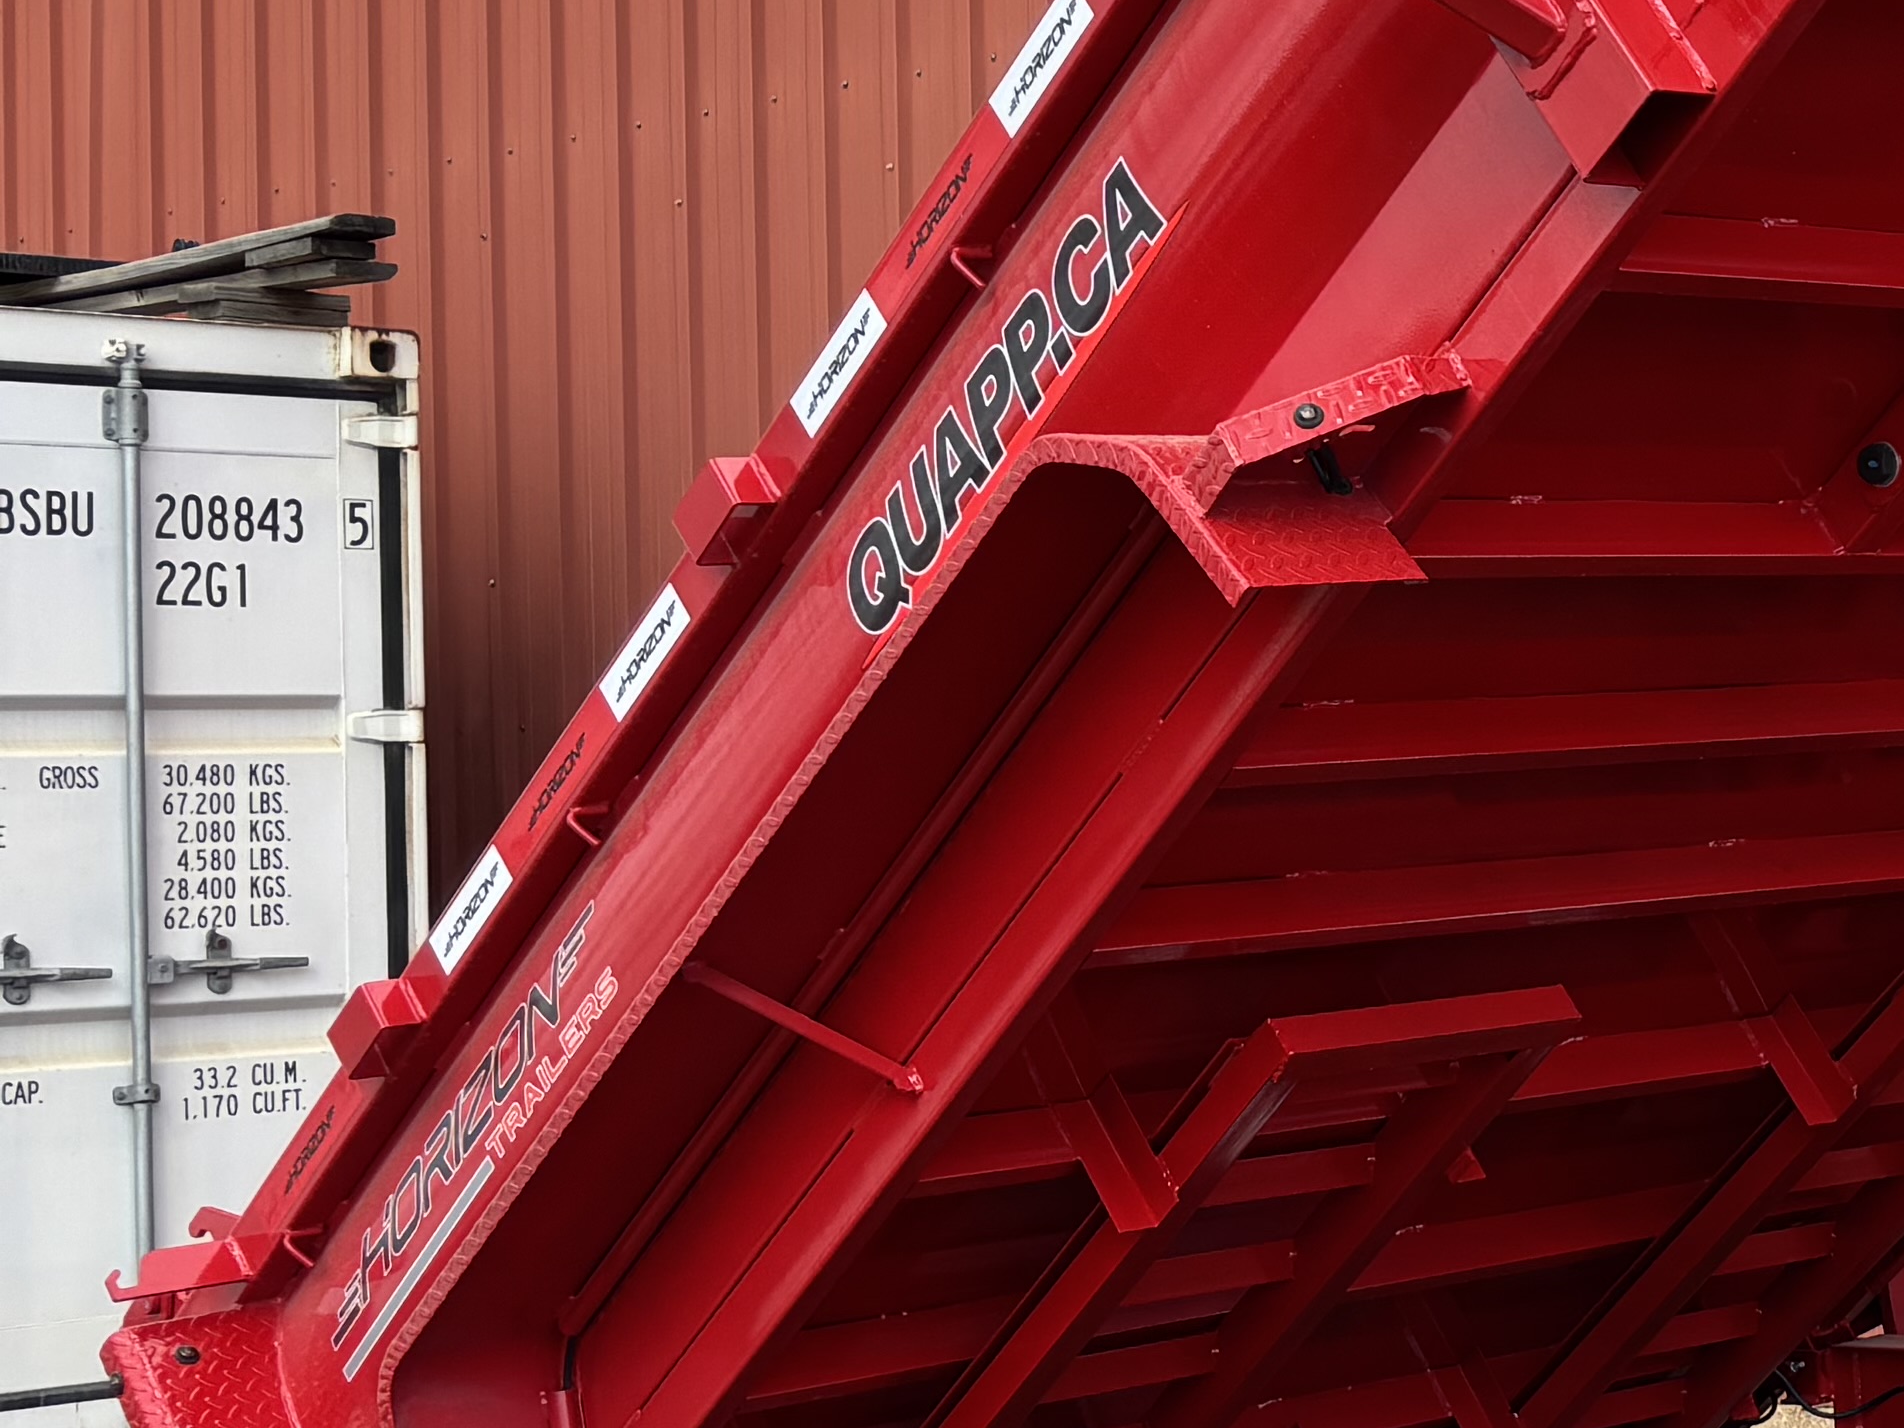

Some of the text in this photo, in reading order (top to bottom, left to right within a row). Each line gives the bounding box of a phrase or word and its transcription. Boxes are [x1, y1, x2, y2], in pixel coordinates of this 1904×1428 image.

[1014, 4, 1072, 106] HORIZON
[911, 162, 968, 260] HORIZON
[811, 315, 866, 410] HORIZON
[846, 156, 1169, 636] QUAPP.CA
[155, 493, 304, 544] 208843
[348, 502, 369, 546] 5
[155, 560, 248, 608] 22G1
[39, 766, 99, 789] GROSS
[249, 764, 291, 786] KGS.
[249, 792, 289, 814] LBS.
[250, 820, 292, 842] KGS.
[250, 848, 290, 870] LBS.
[250, 876, 292, 898] KGS.
[250, 904, 290, 927] LBS.
[486, 967, 619, 1158] TRAILERS
[2, 1081, 43, 1105] CAP.
[193, 1065, 238, 1090] 33.2
[252, 1088, 307, 1114] CU.FT.
[348, 924, 578, 1329] HORIZON
